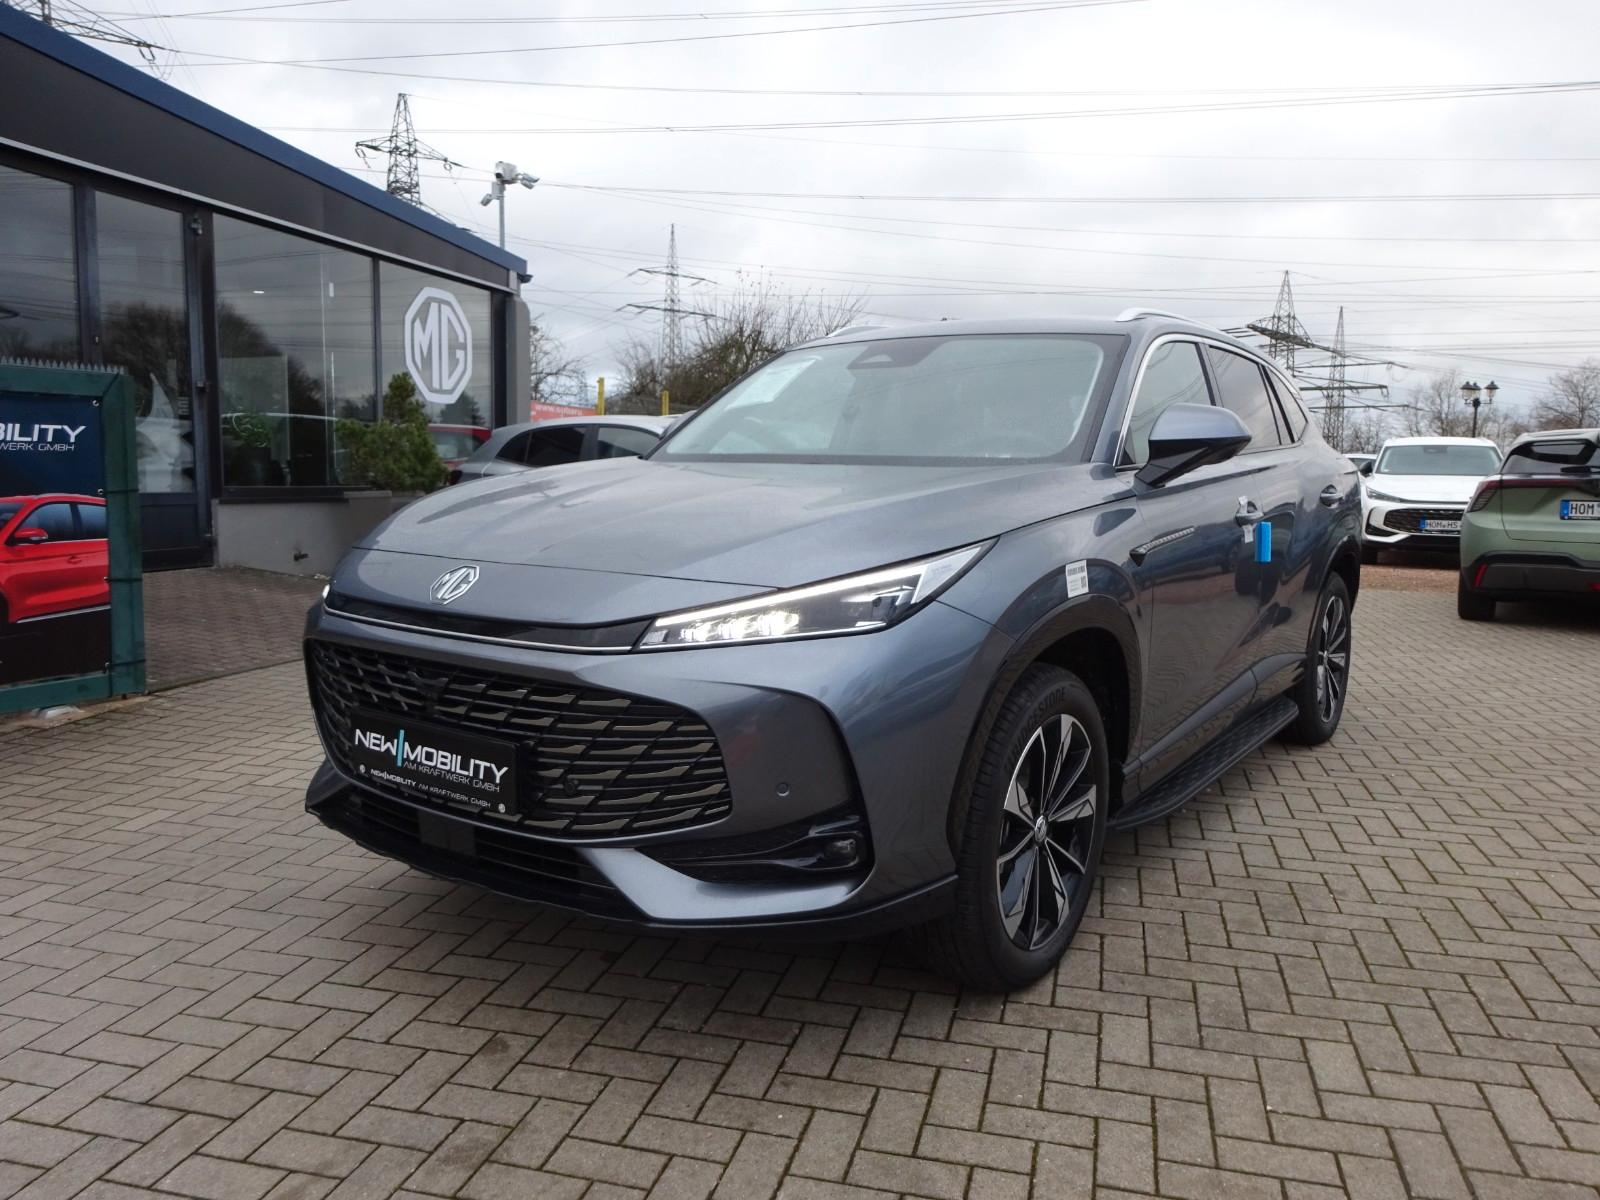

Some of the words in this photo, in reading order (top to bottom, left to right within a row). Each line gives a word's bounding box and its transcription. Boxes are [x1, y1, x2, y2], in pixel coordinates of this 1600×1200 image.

[412, 300, 467, 391] MG
[38, 443, 75, 451] GMBH
[1570, 503, 1595, 515] HOM
[432, 566, 476, 600] MG
[403, 742, 509, 784] MOBILITY
[403, 761, 417, 771] AM
[418, 765, 470, 785] KRAFTWERK
[472, 779, 500, 793] GMBH
[418, 783, 429, 791] AM
[429, 786, 469, 801] KRAFTWERK
[470, 797, 491, 809] GMBH
